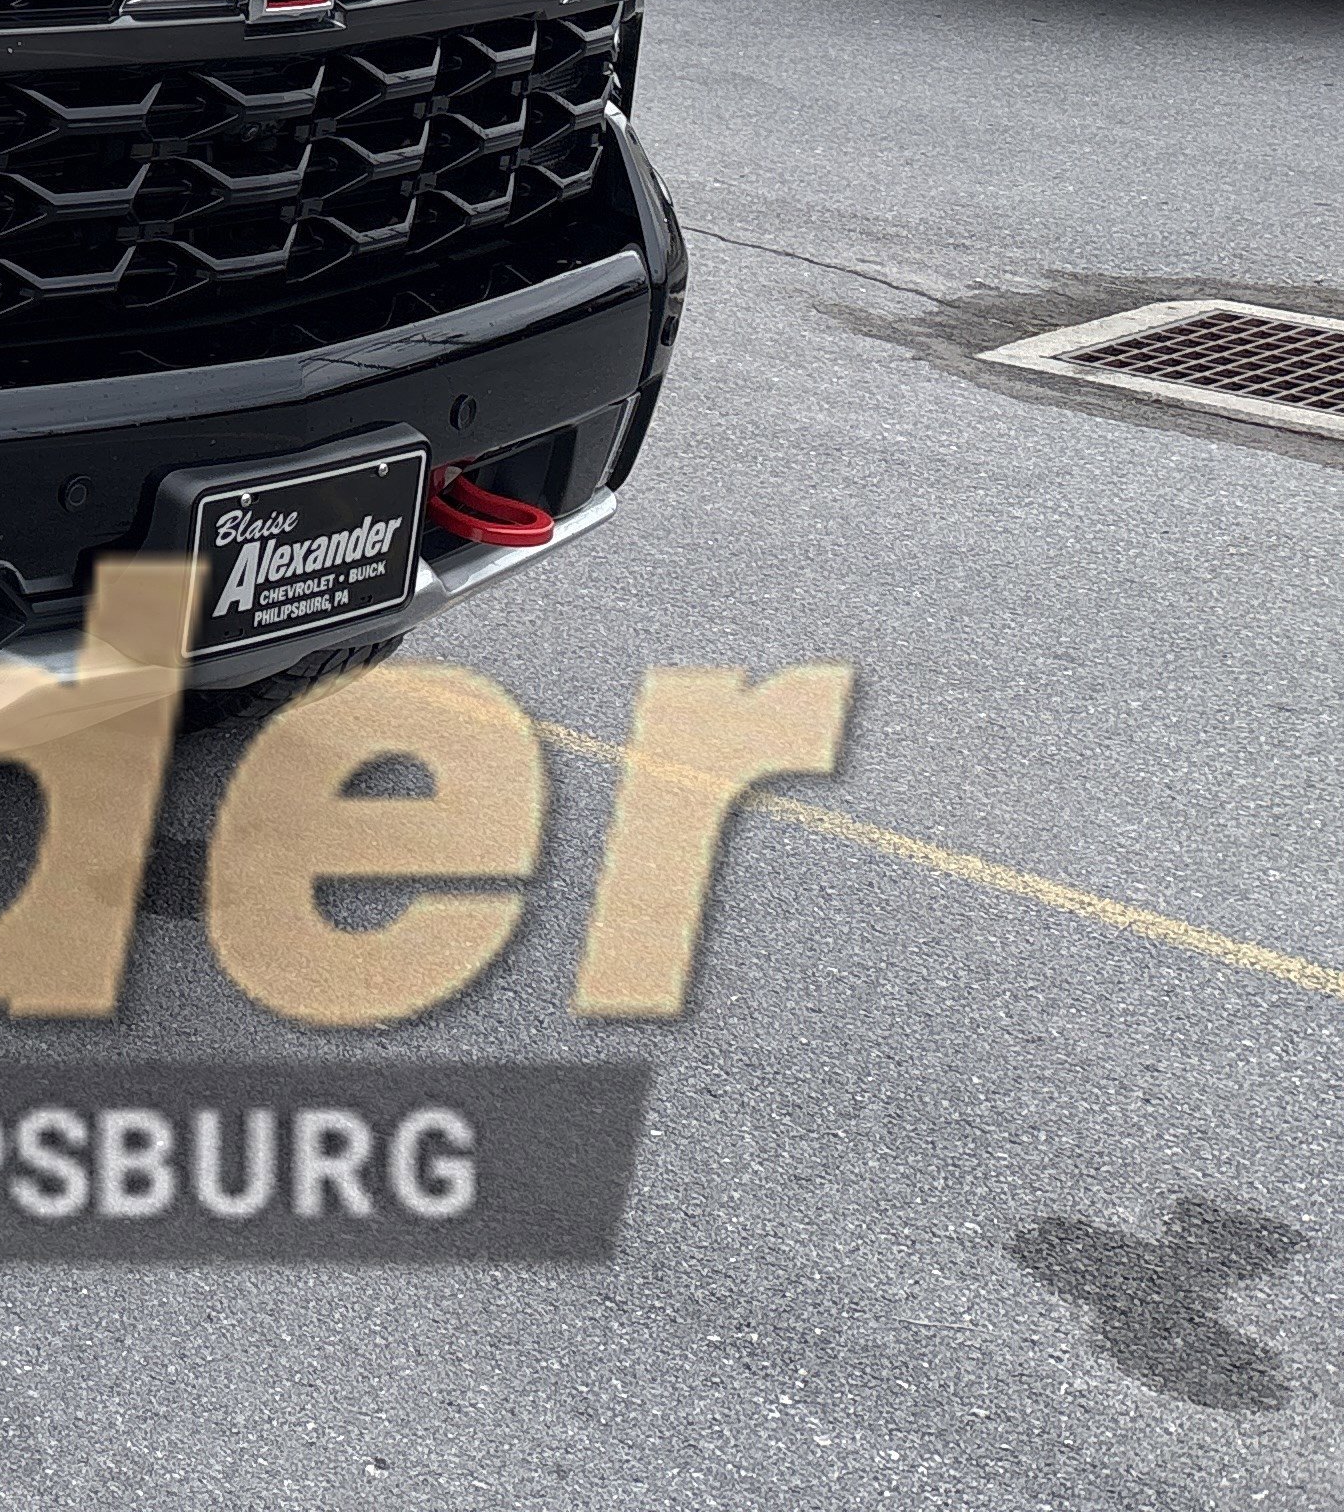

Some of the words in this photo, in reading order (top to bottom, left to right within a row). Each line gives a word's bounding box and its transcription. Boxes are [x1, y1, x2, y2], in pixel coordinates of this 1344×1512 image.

[215, 509, 299, 547] Blaise
[213, 516, 403, 617] Alexander
[259, 575, 335, 606] CHEVROLET
[349, 560, 387, 584] BUICK
[253, 597, 333, 627] PHILIPSBURG,
[333, 589, 350, 606] PA
